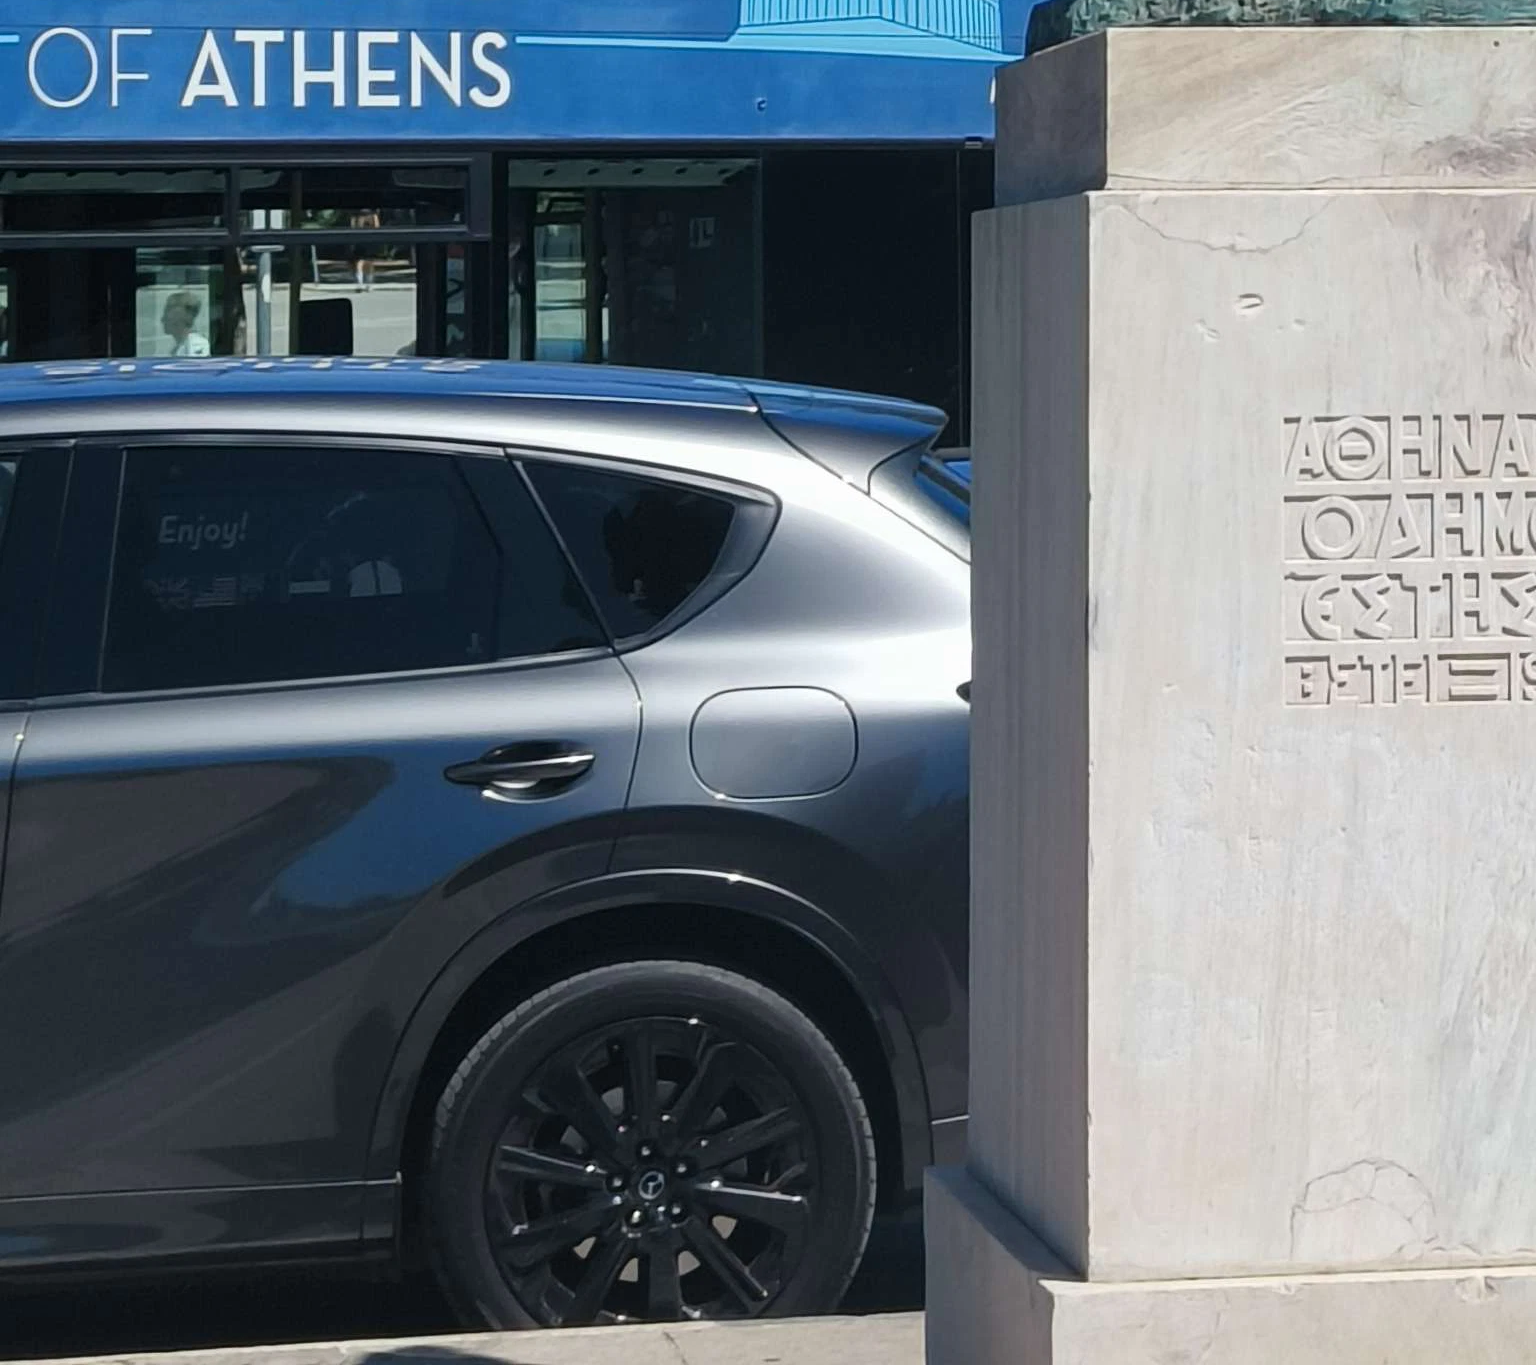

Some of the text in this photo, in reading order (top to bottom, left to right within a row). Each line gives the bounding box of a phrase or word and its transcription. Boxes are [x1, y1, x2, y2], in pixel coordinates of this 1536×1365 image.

[28, 27, 512, 108] OF ATHENS
[159, 511, 249, 550] Enjoy!
